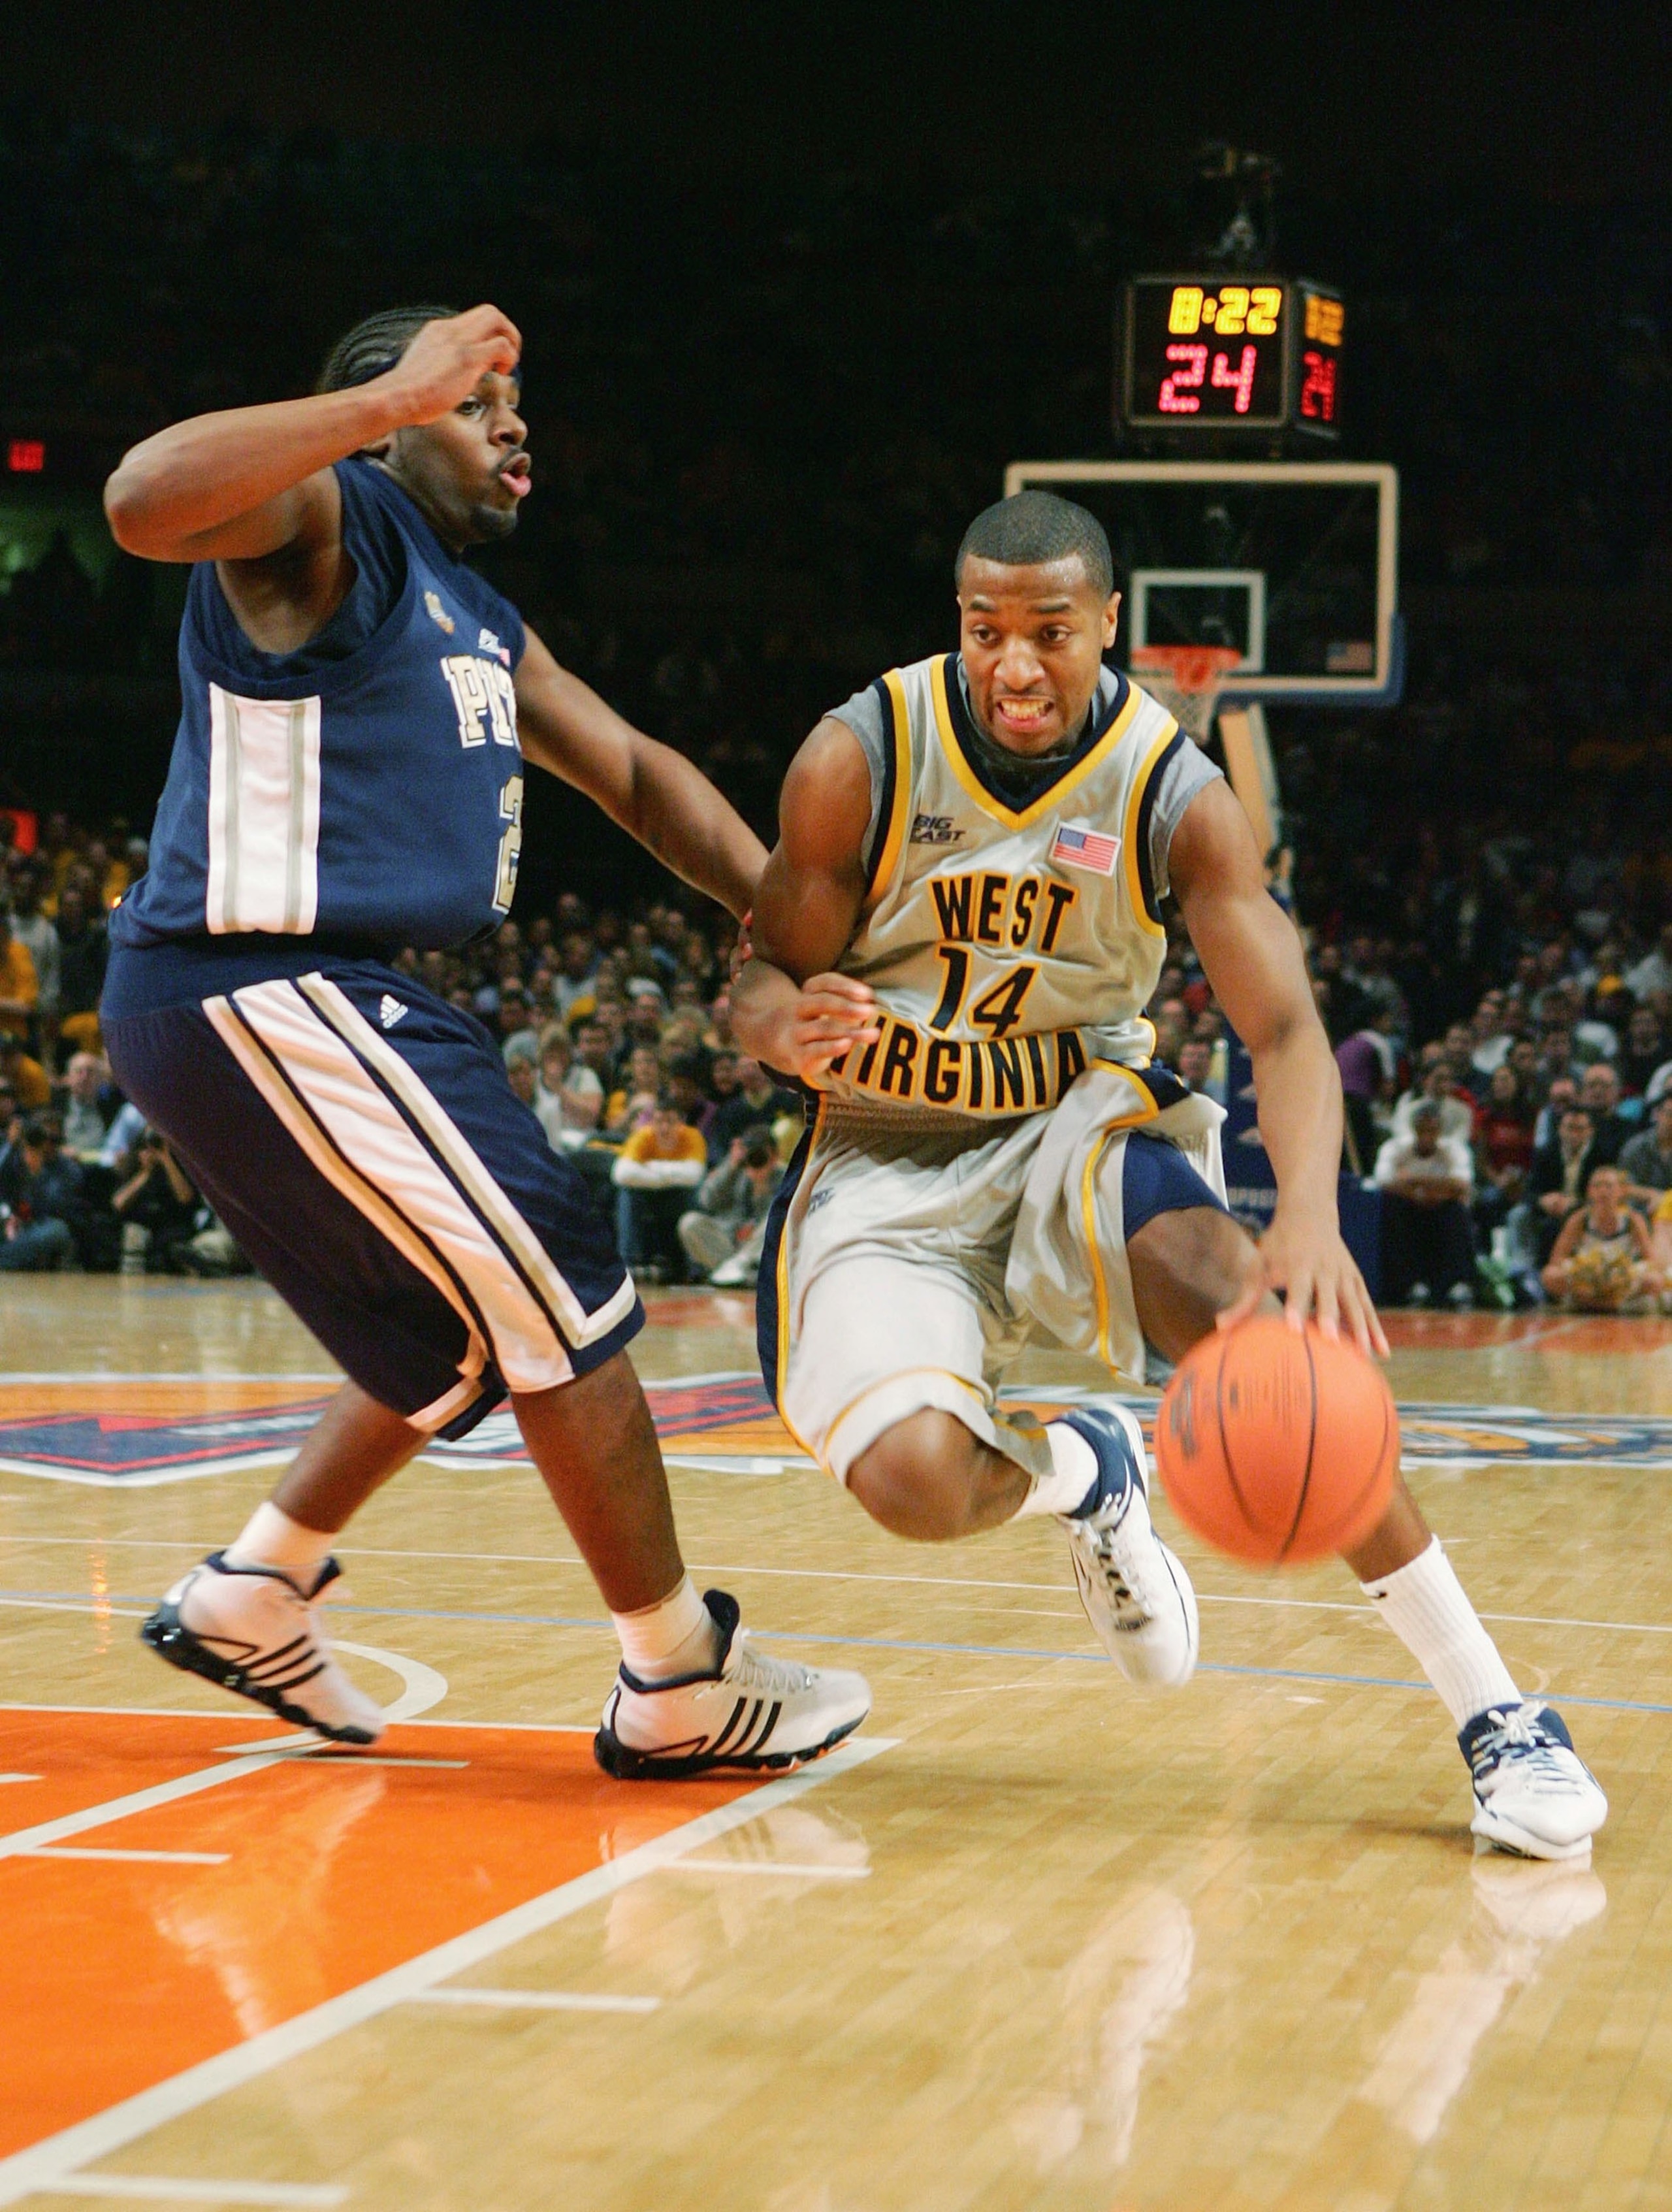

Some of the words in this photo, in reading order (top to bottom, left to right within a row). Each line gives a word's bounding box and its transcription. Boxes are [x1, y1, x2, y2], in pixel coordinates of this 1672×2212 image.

[1168, 286, 1282, 334] 8:22
[1159, 344, 1257, 414] 24
[914, 814, 954, 830] BIG
[928, 870, 1079, 955] WEST
[927, 939, 1042, 1040] 14
[829, 1011, 1089, 1111] IRGINIA
